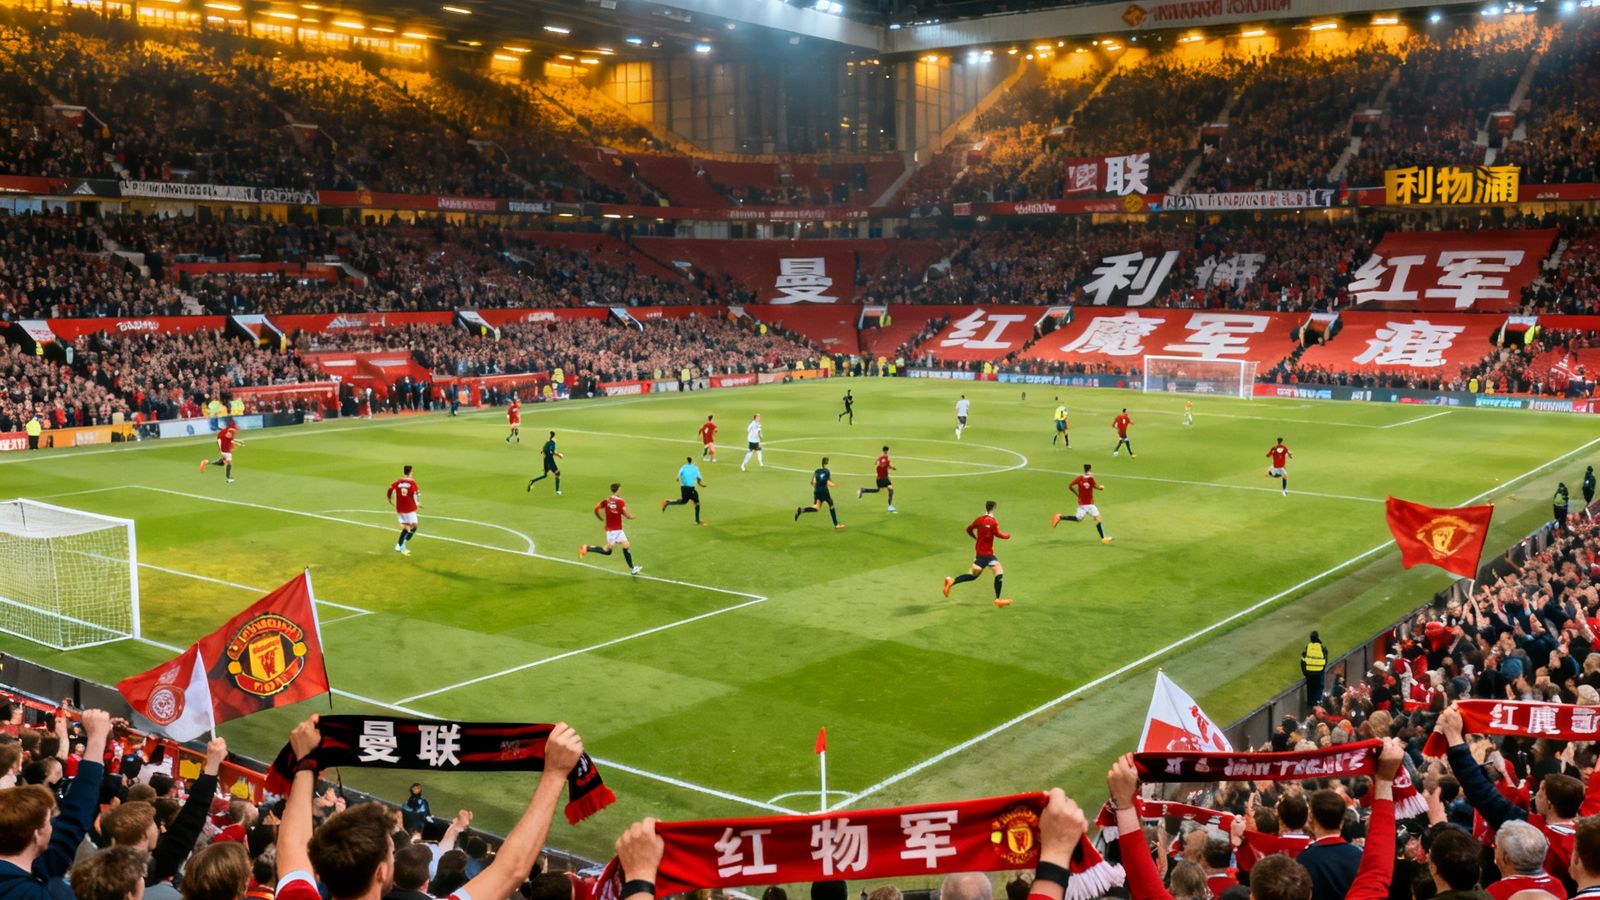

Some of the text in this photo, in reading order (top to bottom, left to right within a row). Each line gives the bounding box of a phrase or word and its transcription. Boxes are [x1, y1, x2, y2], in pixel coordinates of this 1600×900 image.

[769, 257, 839, 304] 曼
[1348, 250, 1526, 309] 红军
[358, 720, 463, 767] 曼联
[714, 810, 960, 879] 红物军
